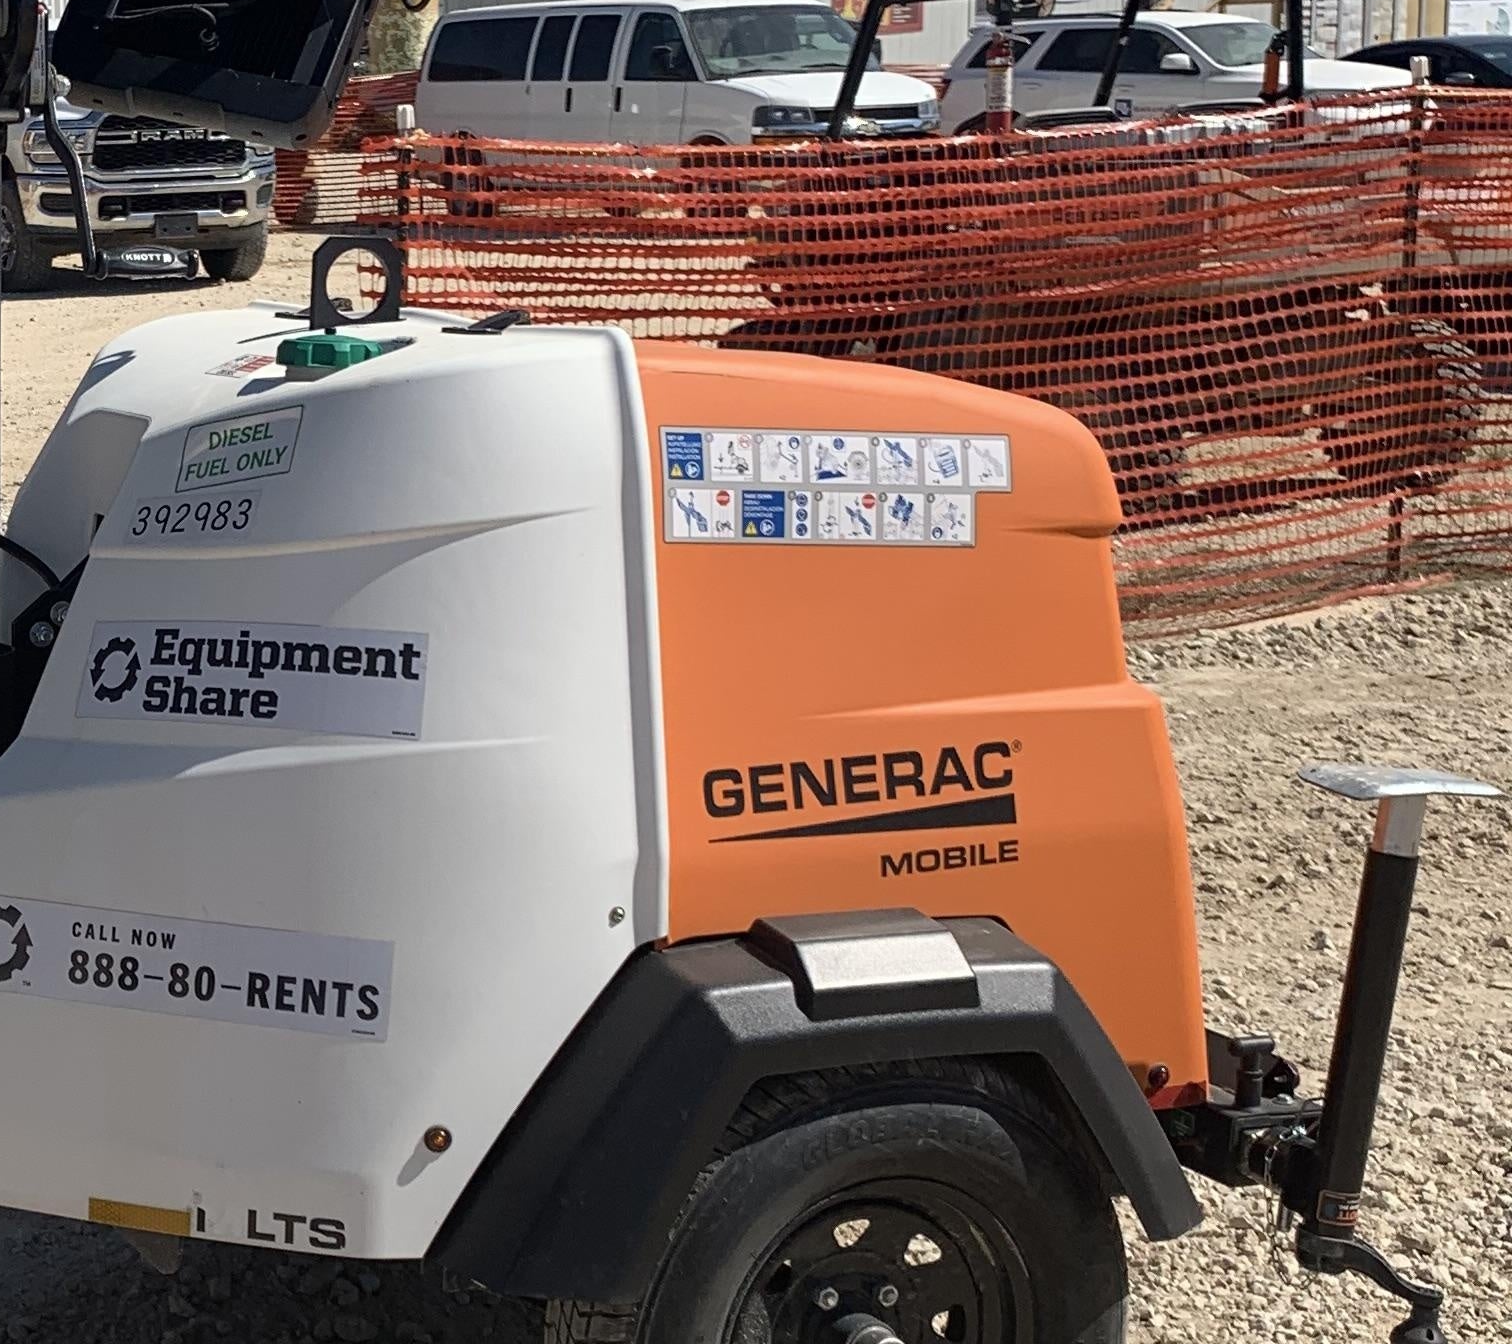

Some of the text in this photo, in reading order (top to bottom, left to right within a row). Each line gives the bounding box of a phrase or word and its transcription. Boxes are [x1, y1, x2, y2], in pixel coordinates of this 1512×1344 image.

[141, 128, 205, 141] RAM
[126, 253, 161, 261] KNOTT
[208, 422, 273, 450] DIESEL
[184, 445, 288, 482] FUEL ONLY
[132, 498, 253, 536] 392983
[150, 628, 421, 680] Equipment
[142, 675, 279, 719] Share
[703, 741, 1013, 818] GENERAC
[880, 839, 1019, 877] MOBILE
[71, 921, 176, 950] CALL NOW
[68, 950, 380, 1022] 888-80-RENTS
[247, 1209, 346, 1250] LTS
